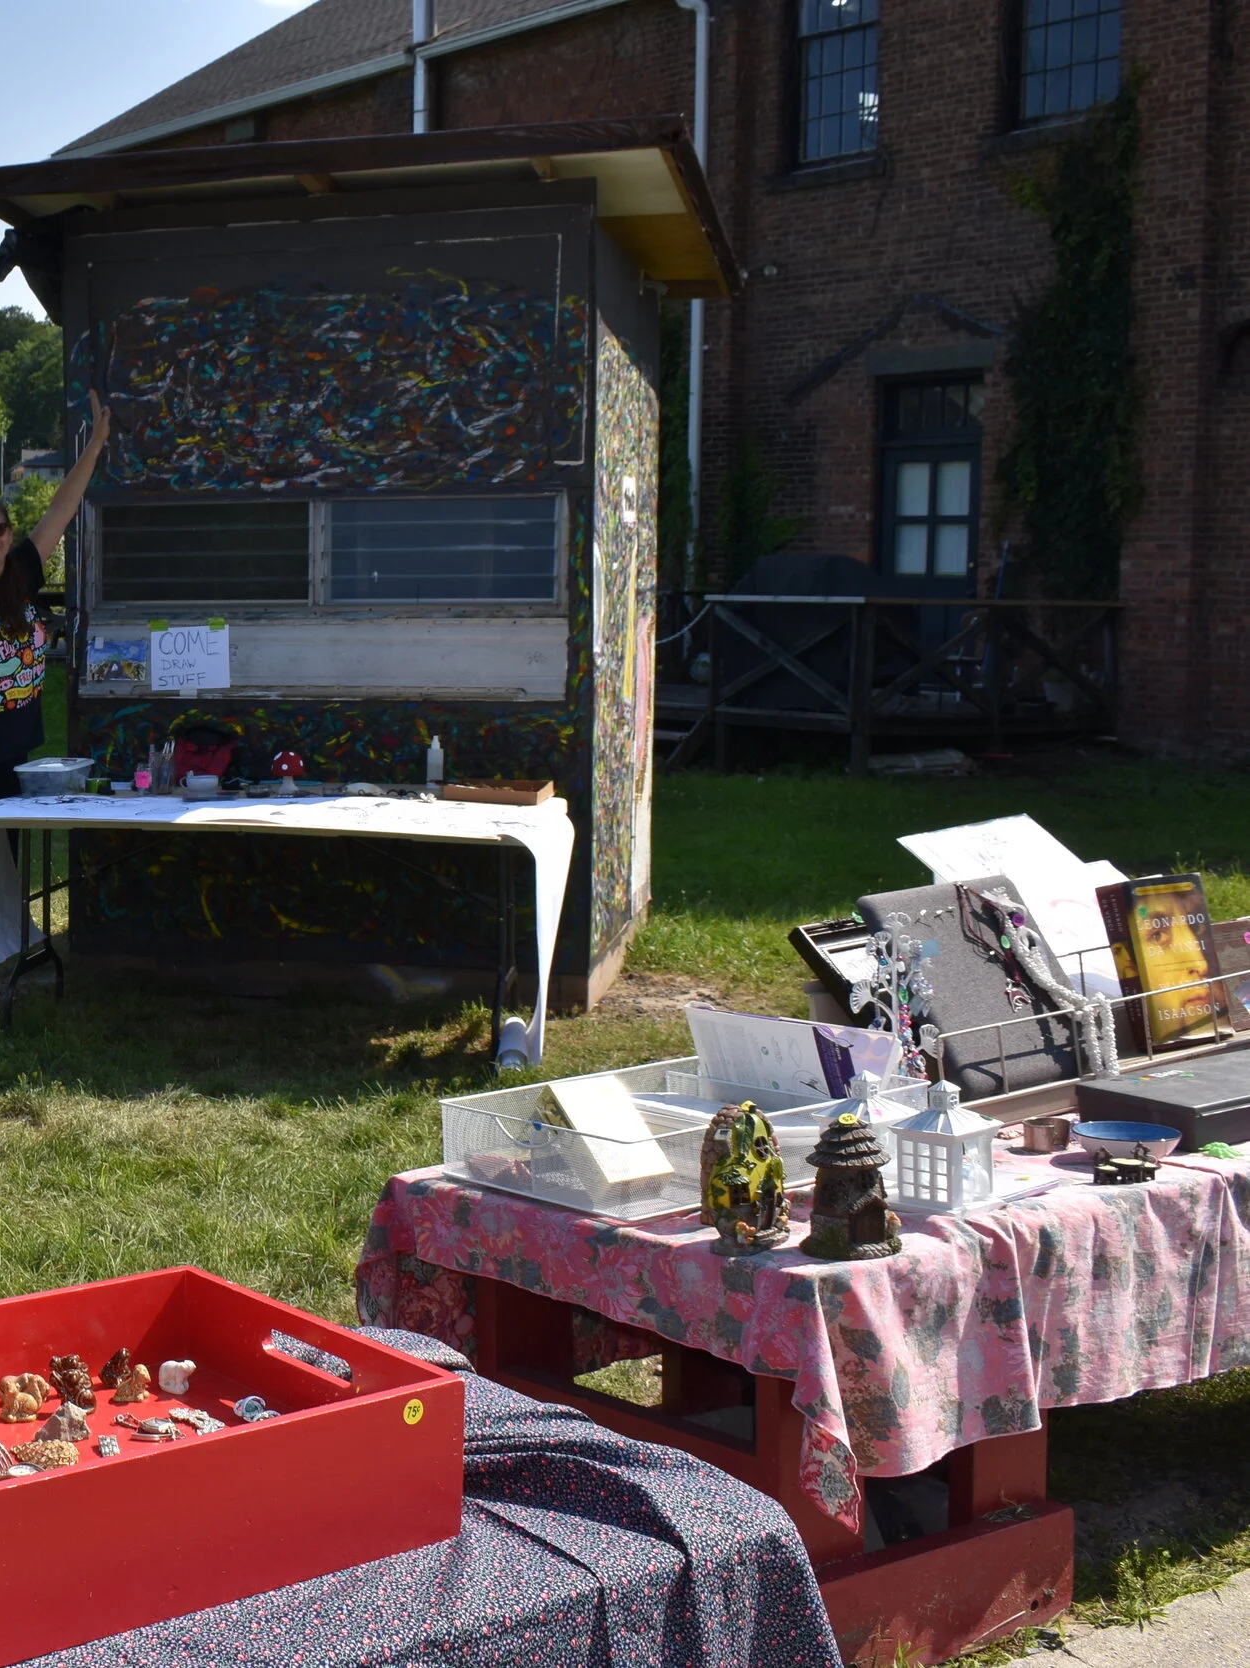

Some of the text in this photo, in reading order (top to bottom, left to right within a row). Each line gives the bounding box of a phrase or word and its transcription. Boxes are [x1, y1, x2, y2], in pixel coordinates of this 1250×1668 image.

[158, 630, 221, 656] COME
[160, 658, 197, 671] DRAW
[158, 672, 207, 687] STUFF
[1136, 913, 1205, 931] LEONARDO
[1148, 944, 1166, 957] DA
